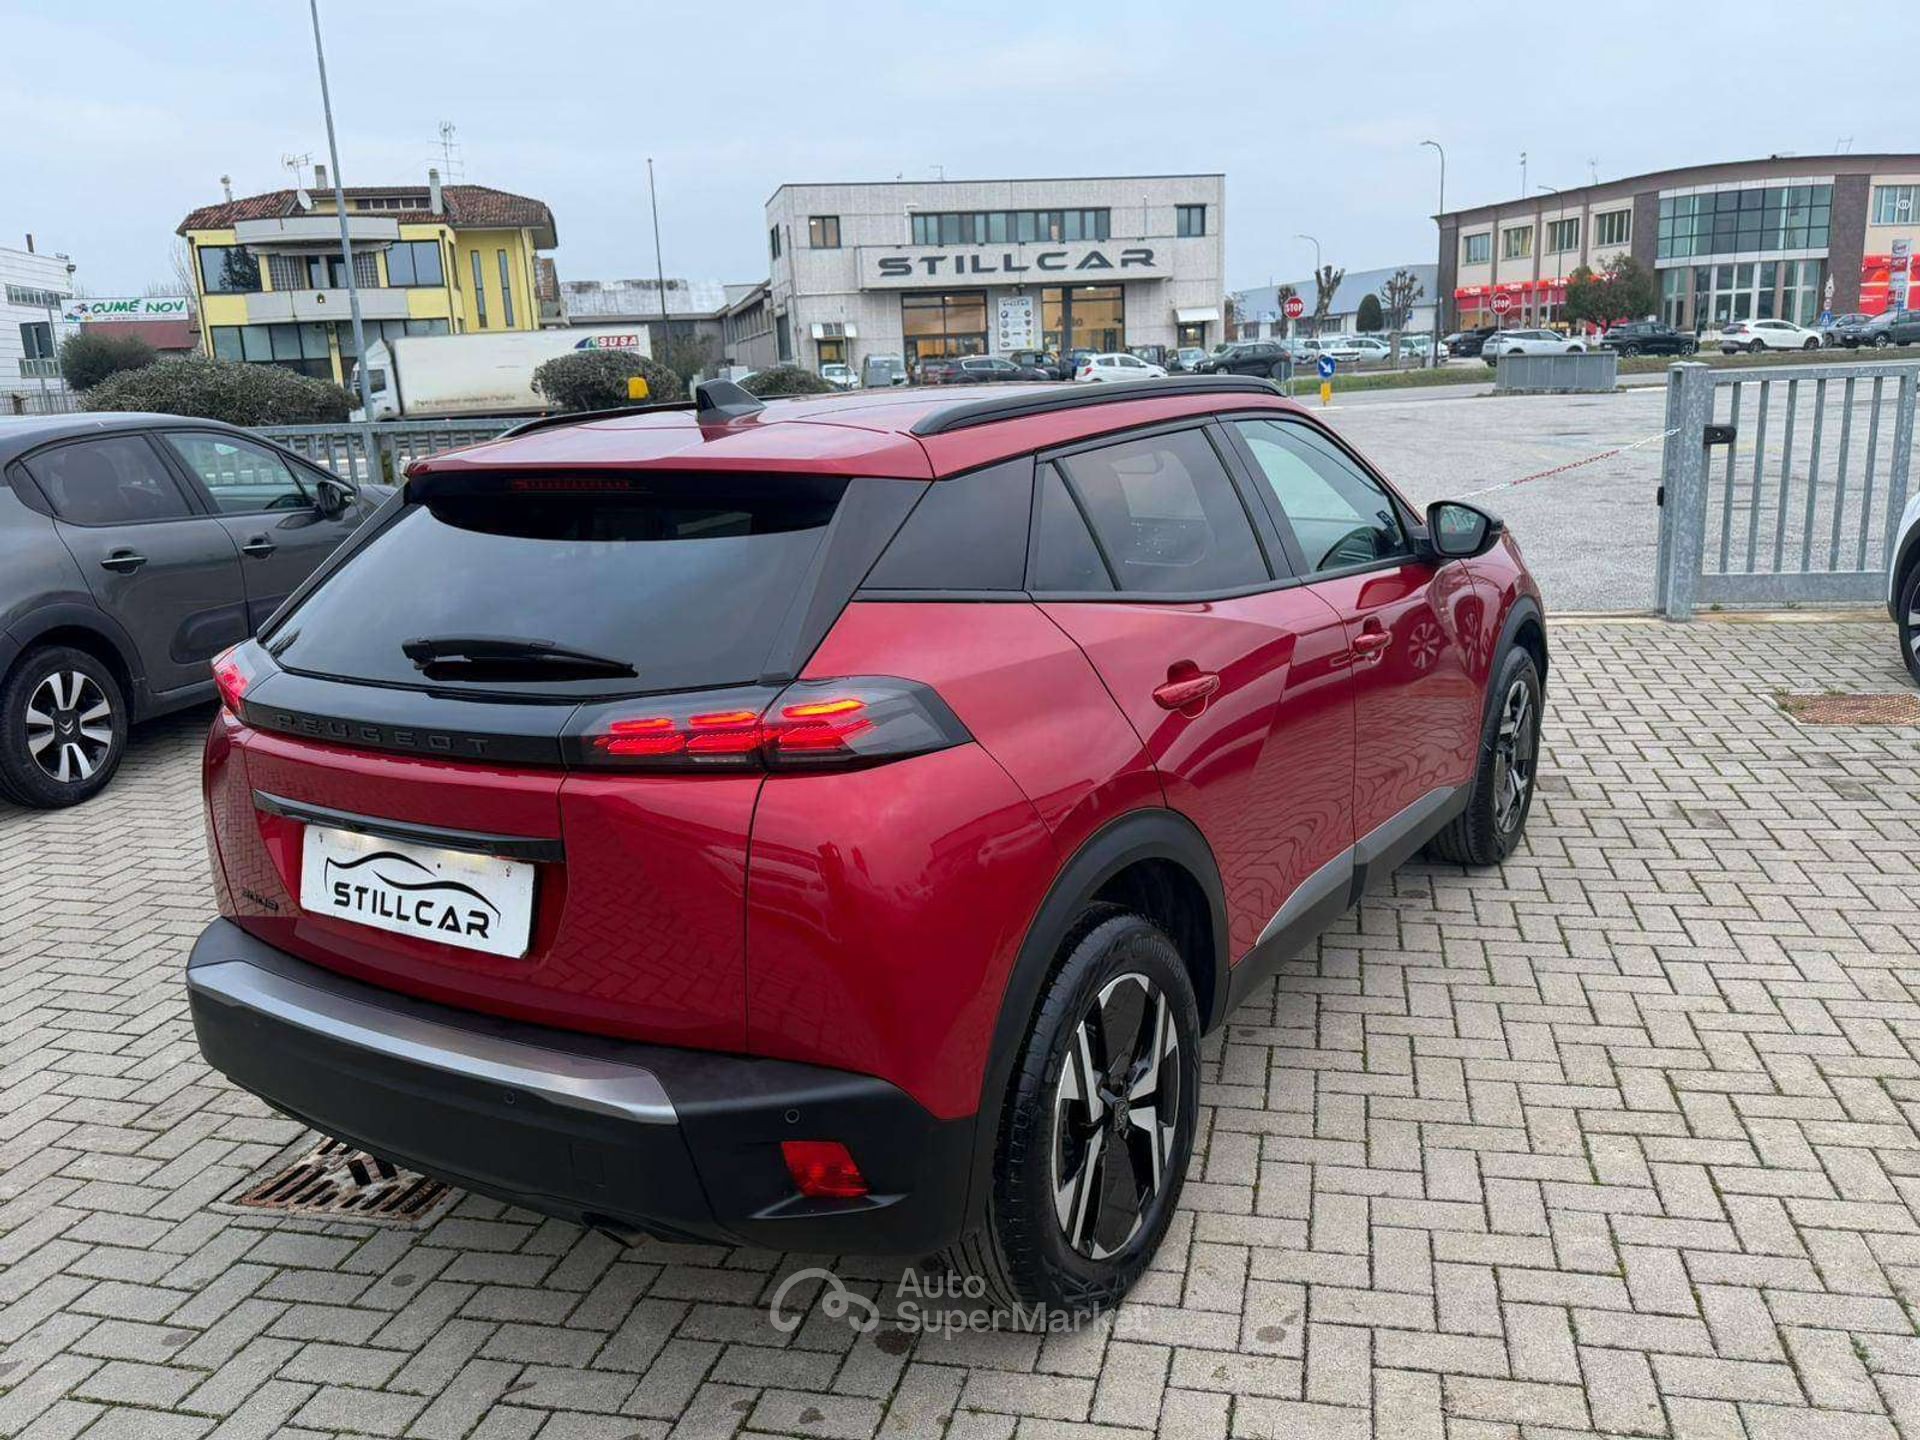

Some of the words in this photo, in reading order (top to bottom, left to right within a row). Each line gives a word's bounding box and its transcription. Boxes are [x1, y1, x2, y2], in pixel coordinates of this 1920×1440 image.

[878, 249, 1158, 277] STILLCAR
[145, 300, 185, 313] NOV
[1285, 303, 1304, 313] STOP
[1491, 299, 1510, 308] STOP
[1055, 316, 1084, 328] Ato
[599, 335, 638, 347] SUSA
[275, 714, 490, 752] PEUGEOT
[334, 881, 489, 939] STILLCAR
